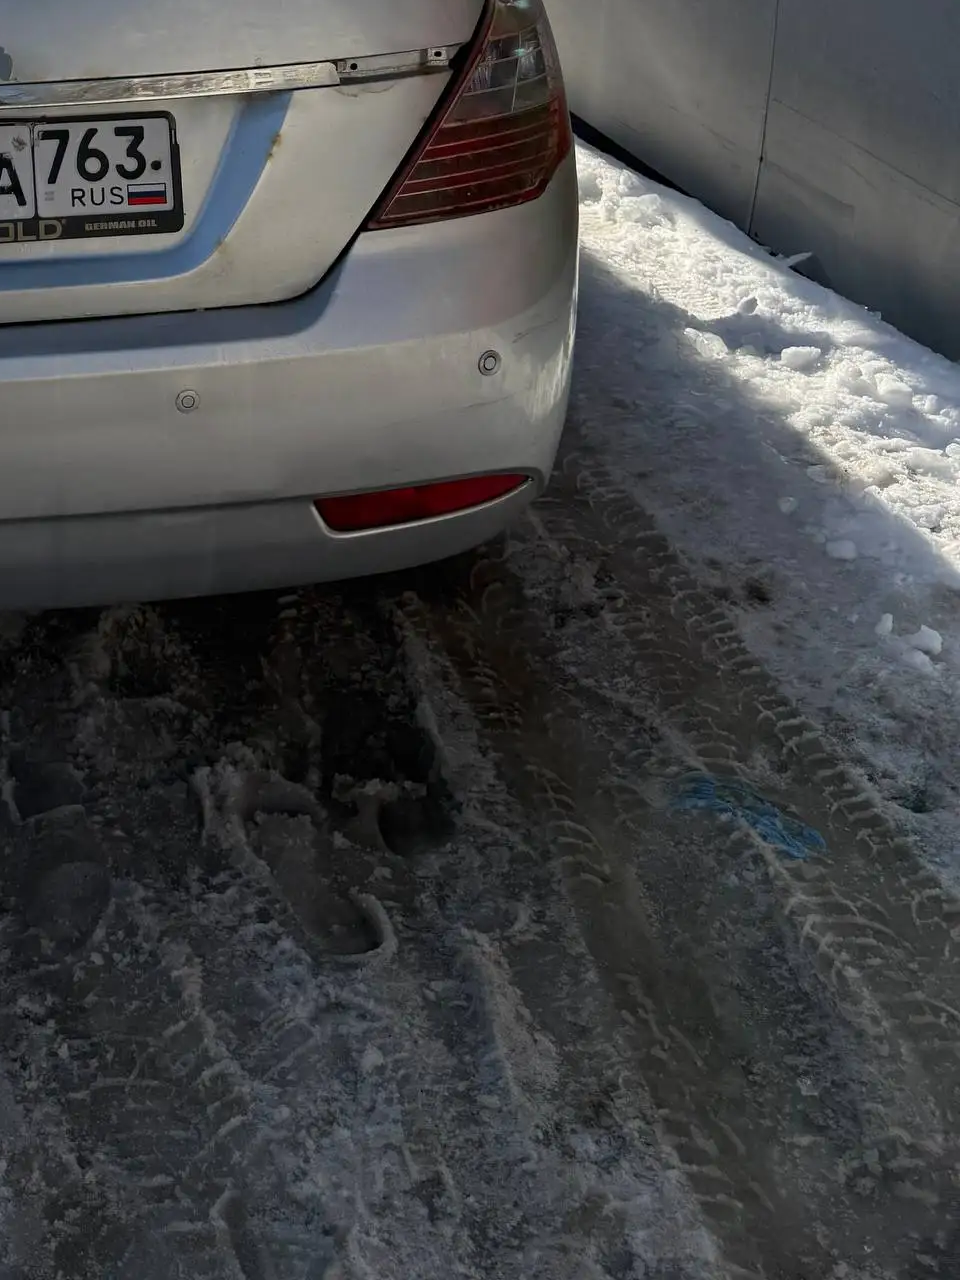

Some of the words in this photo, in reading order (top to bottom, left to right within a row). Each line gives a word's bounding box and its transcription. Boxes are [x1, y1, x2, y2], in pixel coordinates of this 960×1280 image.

[39, 126, 147, 184] 763
[72, 187, 124, 207] RUS
[85, 221, 136, 231] GERMAN
[138, 219, 158, 228] OIL
